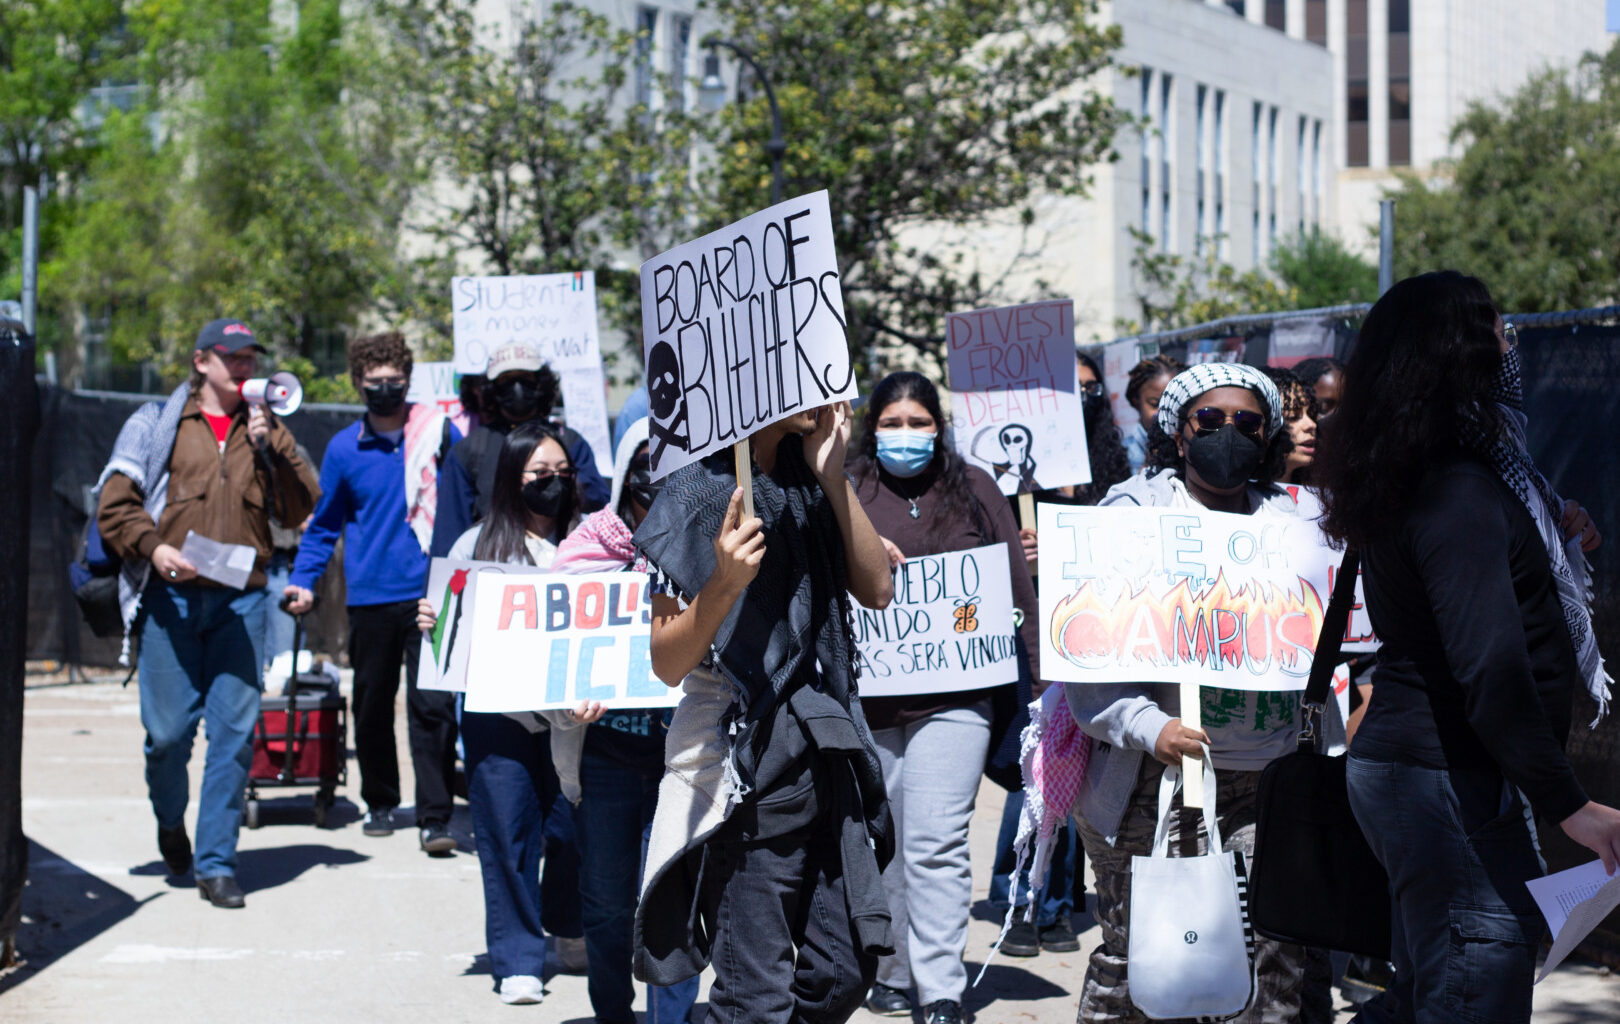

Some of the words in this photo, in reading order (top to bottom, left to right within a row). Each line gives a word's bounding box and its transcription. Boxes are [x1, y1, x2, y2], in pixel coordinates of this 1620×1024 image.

[458, 277, 570, 312] Student
[654, 235, 756, 335] BOARD
[763, 208, 811, 290] OF
[485, 314, 560, 332] money
[949, 302, 1073, 351] DIVEST
[677, 270, 854, 455] BUTCHERS
[968, 338, 1052, 389] FROM
[963, 375, 1060, 427] DEATH
[893, 553, 980, 605] UEBLO
[857, 645, 892, 679] ÁS
[896, 639, 949, 674] SERÁ
[1058, 605, 1316, 678] CAMPUS
[544, 634, 669, 704] ICE
